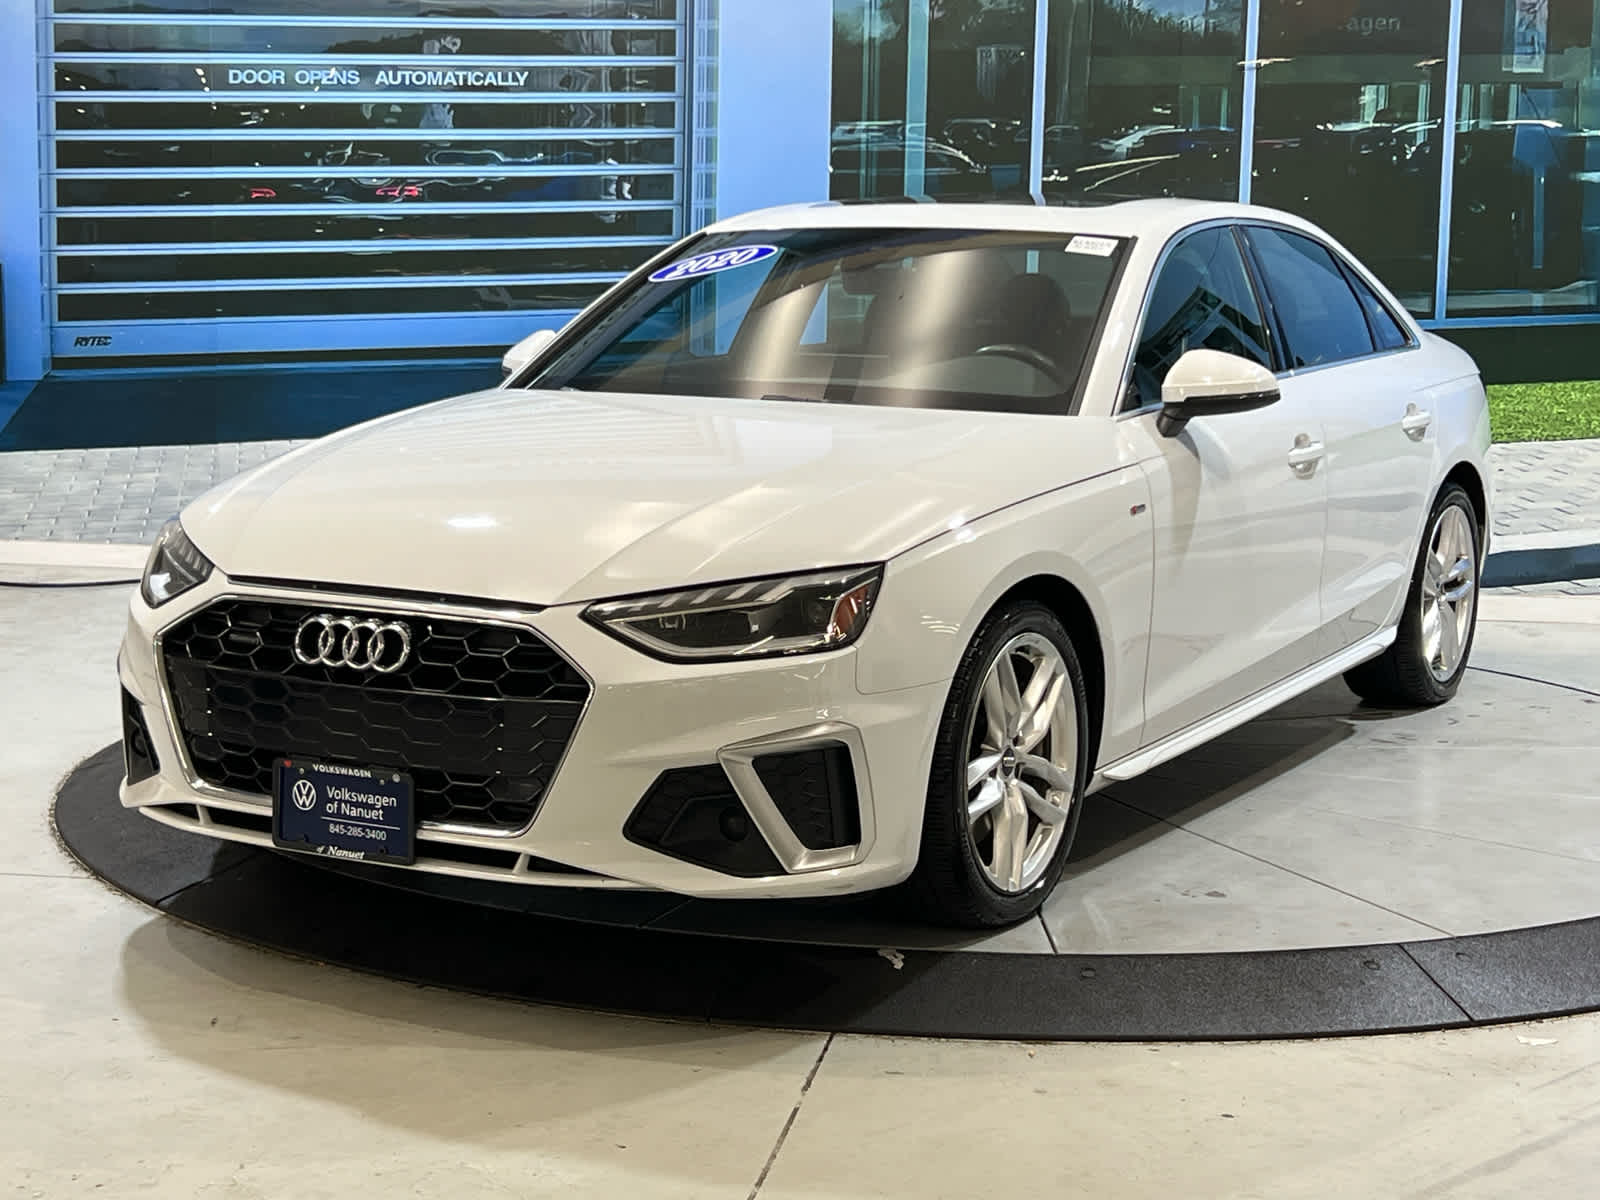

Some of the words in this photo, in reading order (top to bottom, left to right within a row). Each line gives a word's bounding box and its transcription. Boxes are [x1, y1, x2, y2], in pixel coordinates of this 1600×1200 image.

[228, 68, 286, 85] DOOR
[294, 68, 361, 86] OPENS
[375, 70, 530, 87] AUTOMATICALLY
[664, 248, 759, 280] 2020
[74, 336, 113, 347] RYTEC
[312, 764, 372, 778] VOLKSWAGEN
[326, 785, 397, 807] Volkswagen
[326, 801, 339, 814] of
[341, 802, 384, 820] Nanuet
[328, 823, 387, 840] 845-285-3400
[327, 845, 365, 860] Nanuet
